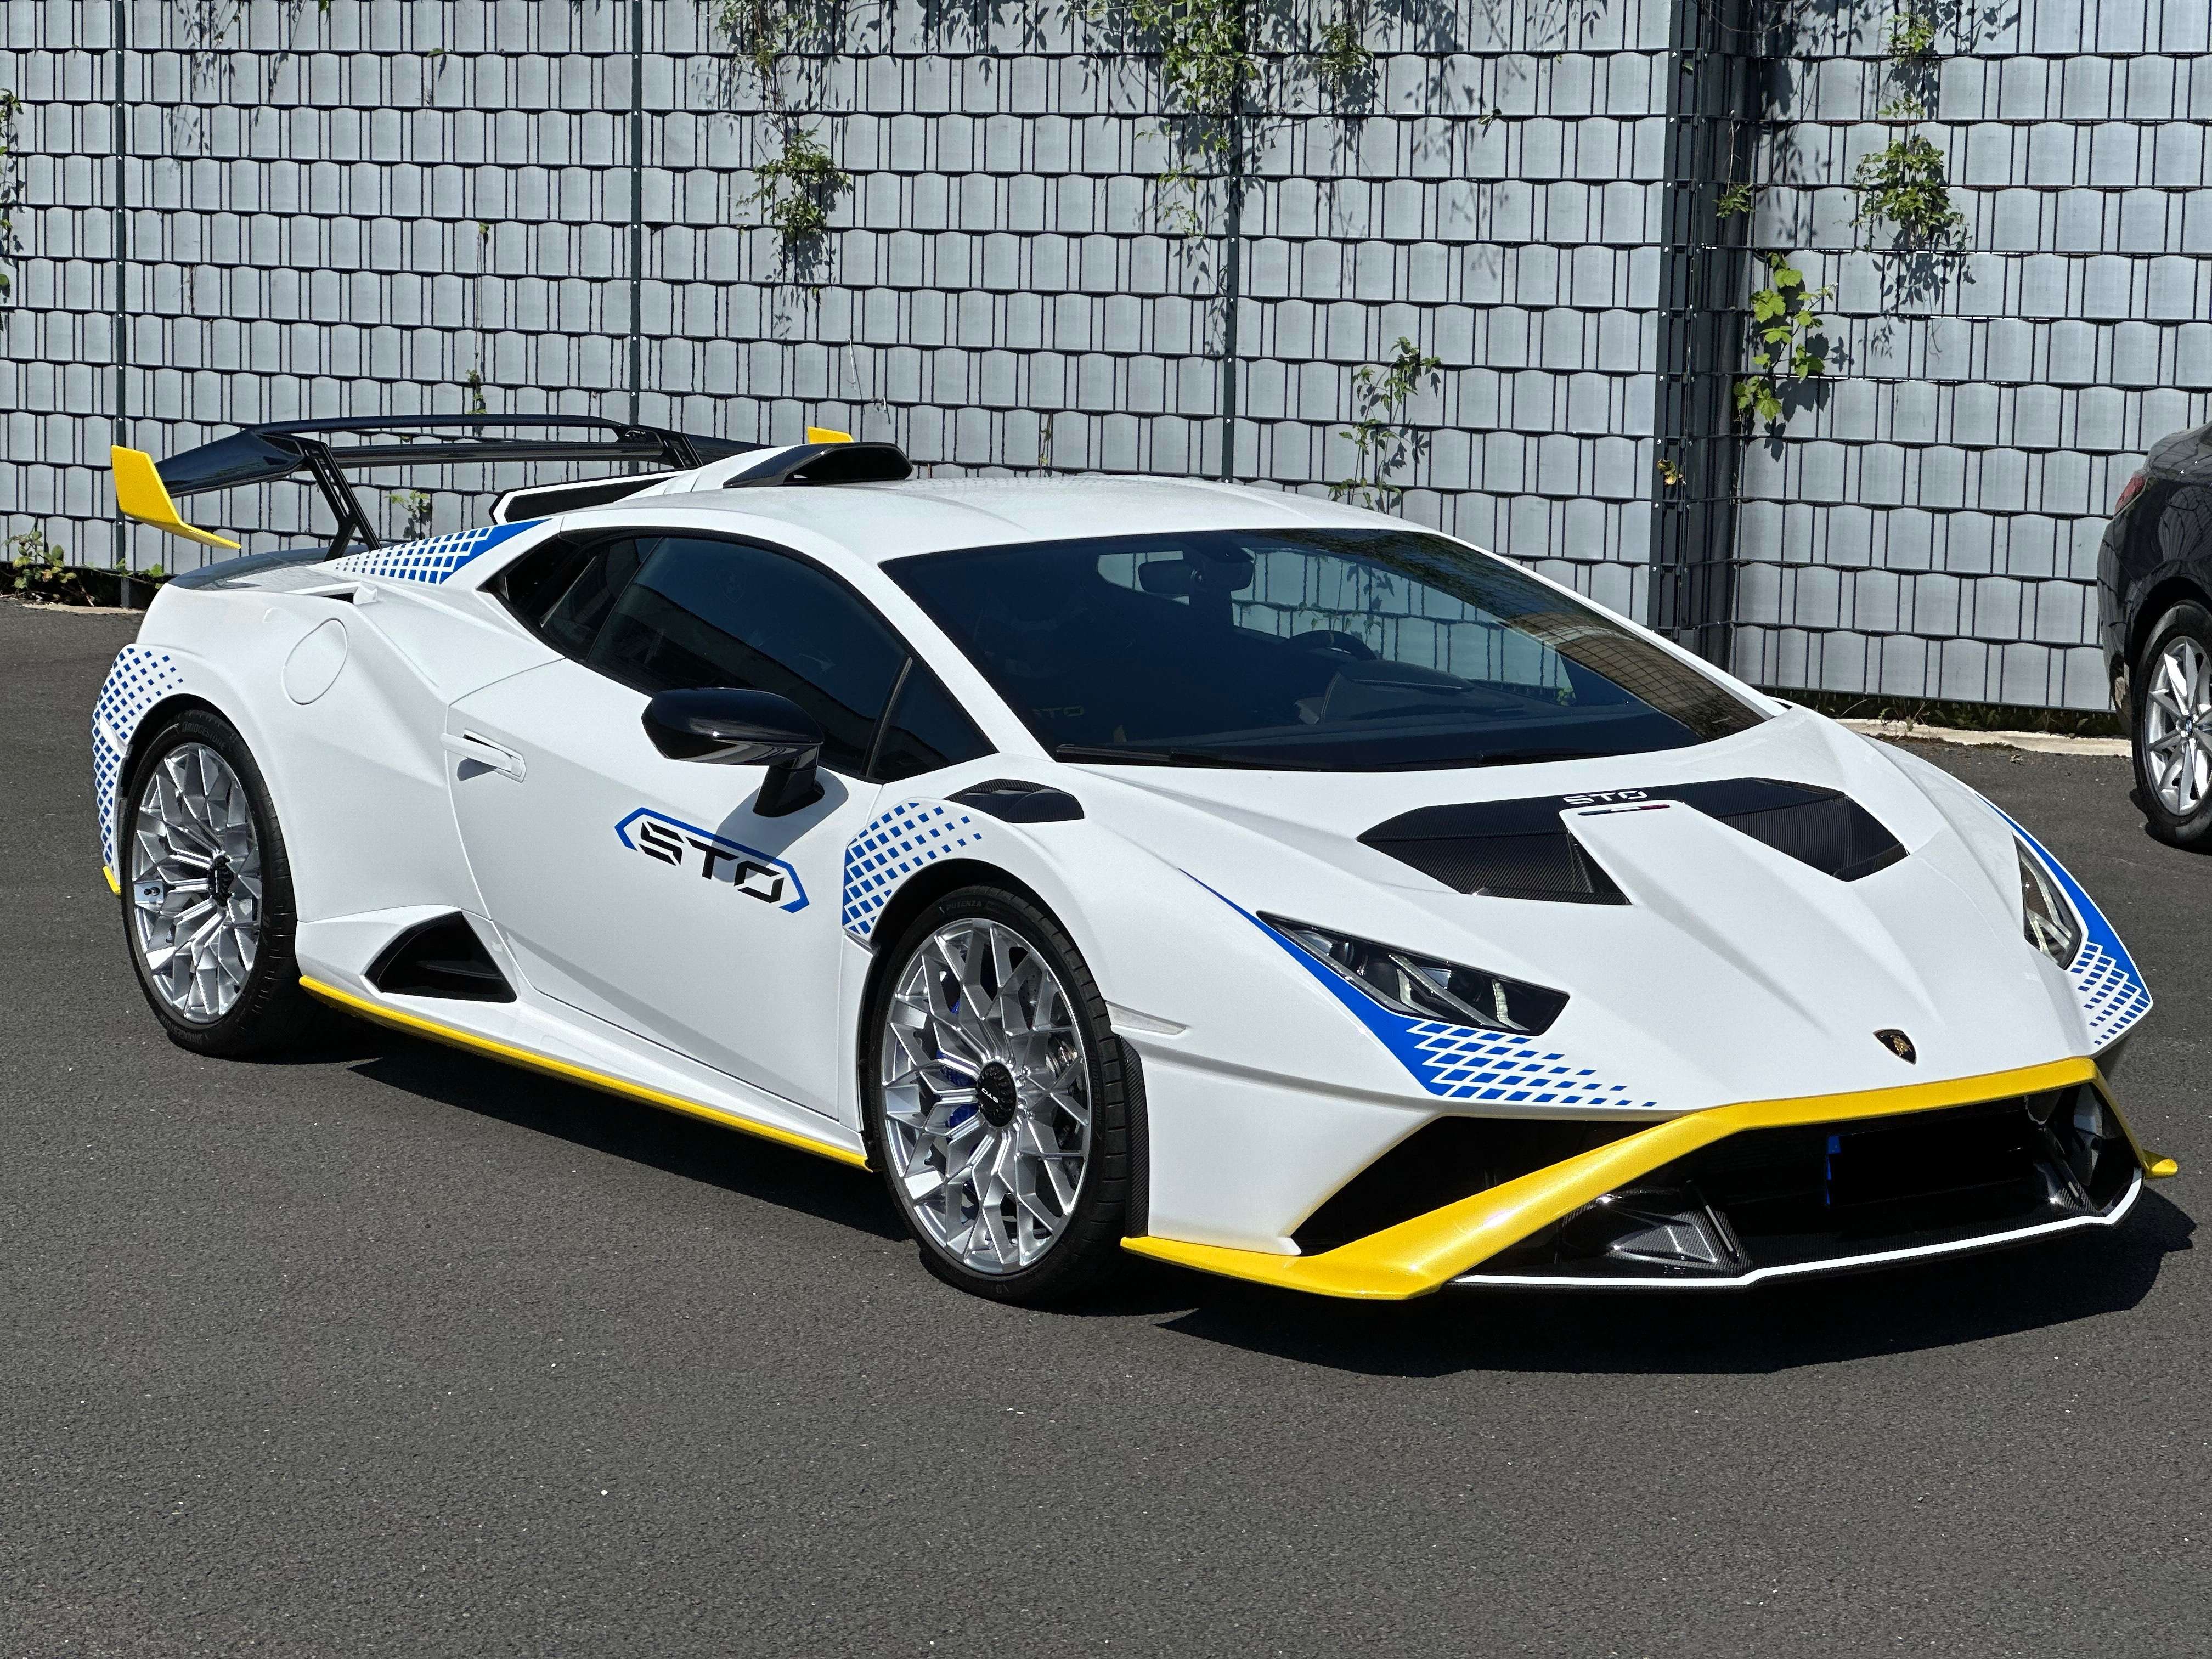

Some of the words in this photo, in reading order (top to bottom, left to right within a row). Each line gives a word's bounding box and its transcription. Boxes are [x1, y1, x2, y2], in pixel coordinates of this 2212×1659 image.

[1563, 791, 1647, 805] STO
[639, 821, 785, 904] STO
[981, 1088, 998, 1103] STO
